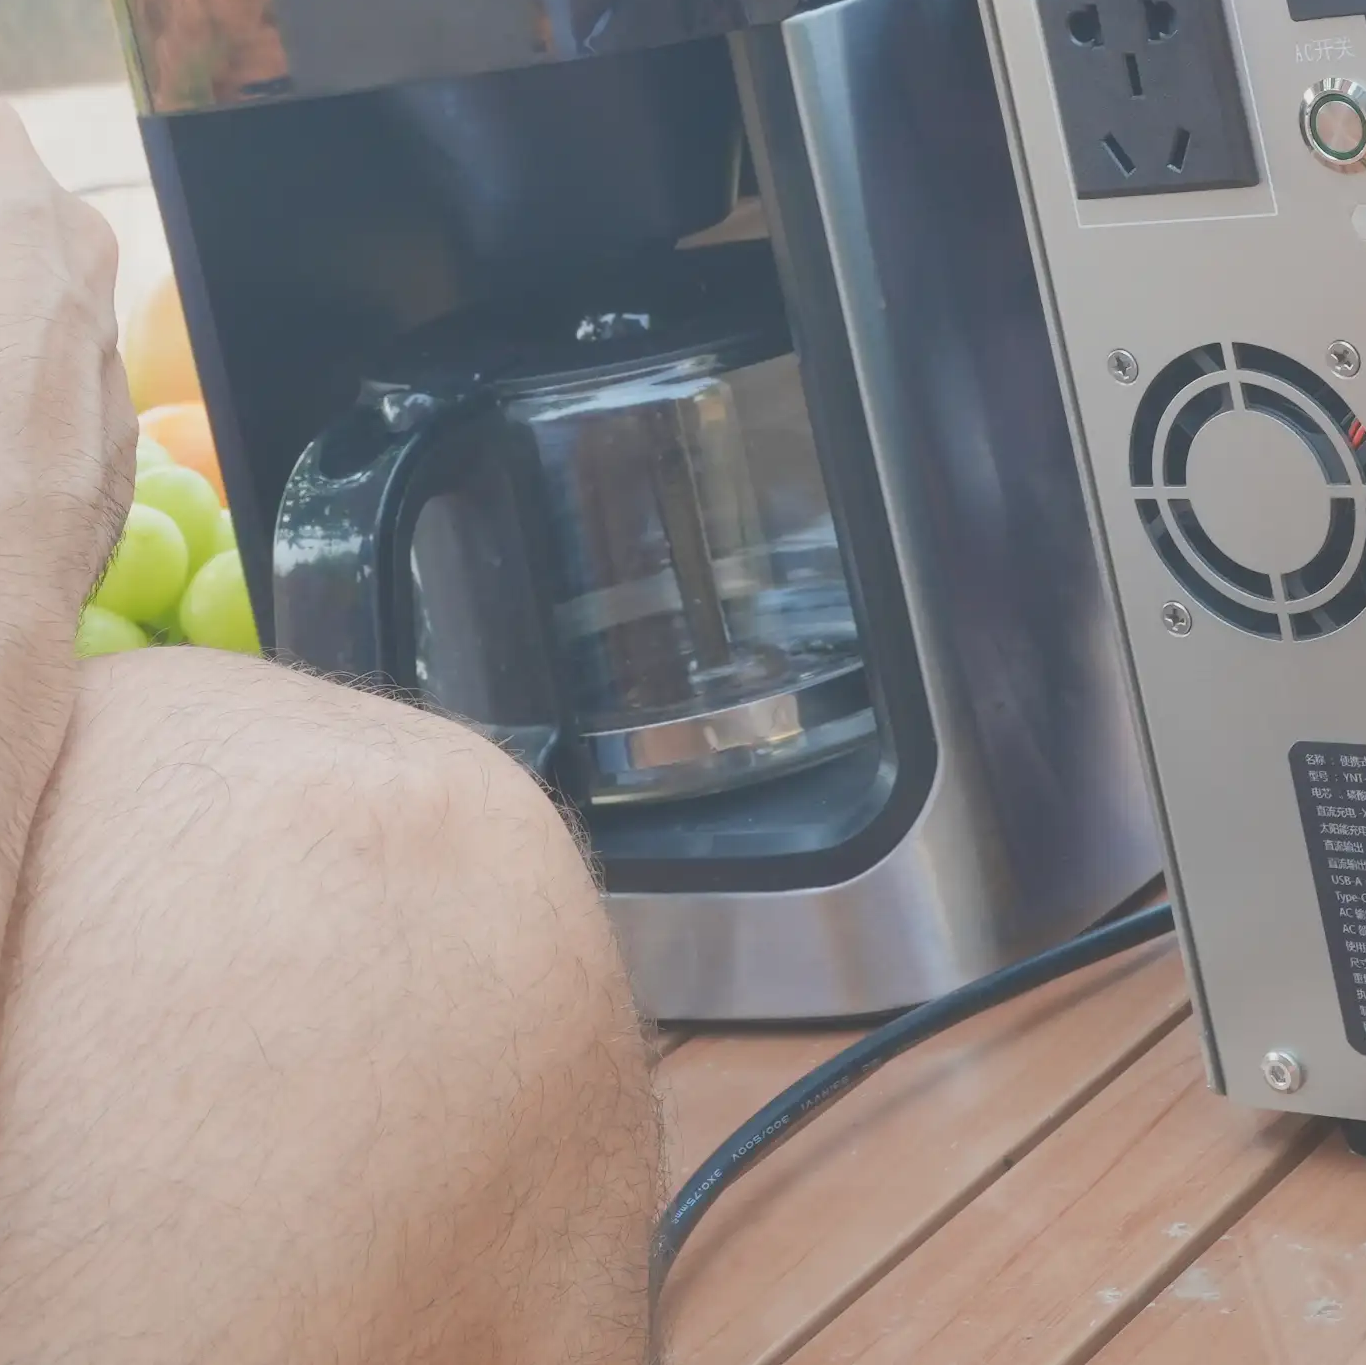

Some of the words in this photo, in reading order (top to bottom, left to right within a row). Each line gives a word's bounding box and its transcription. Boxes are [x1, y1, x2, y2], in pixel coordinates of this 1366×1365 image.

[1295, 36, 1356, 64] AC开关
[1339, 907, 1353, 918] AC
[1342, 923, 1356, 934] AC
[731, 1114, 790, 1162] 300/500V
